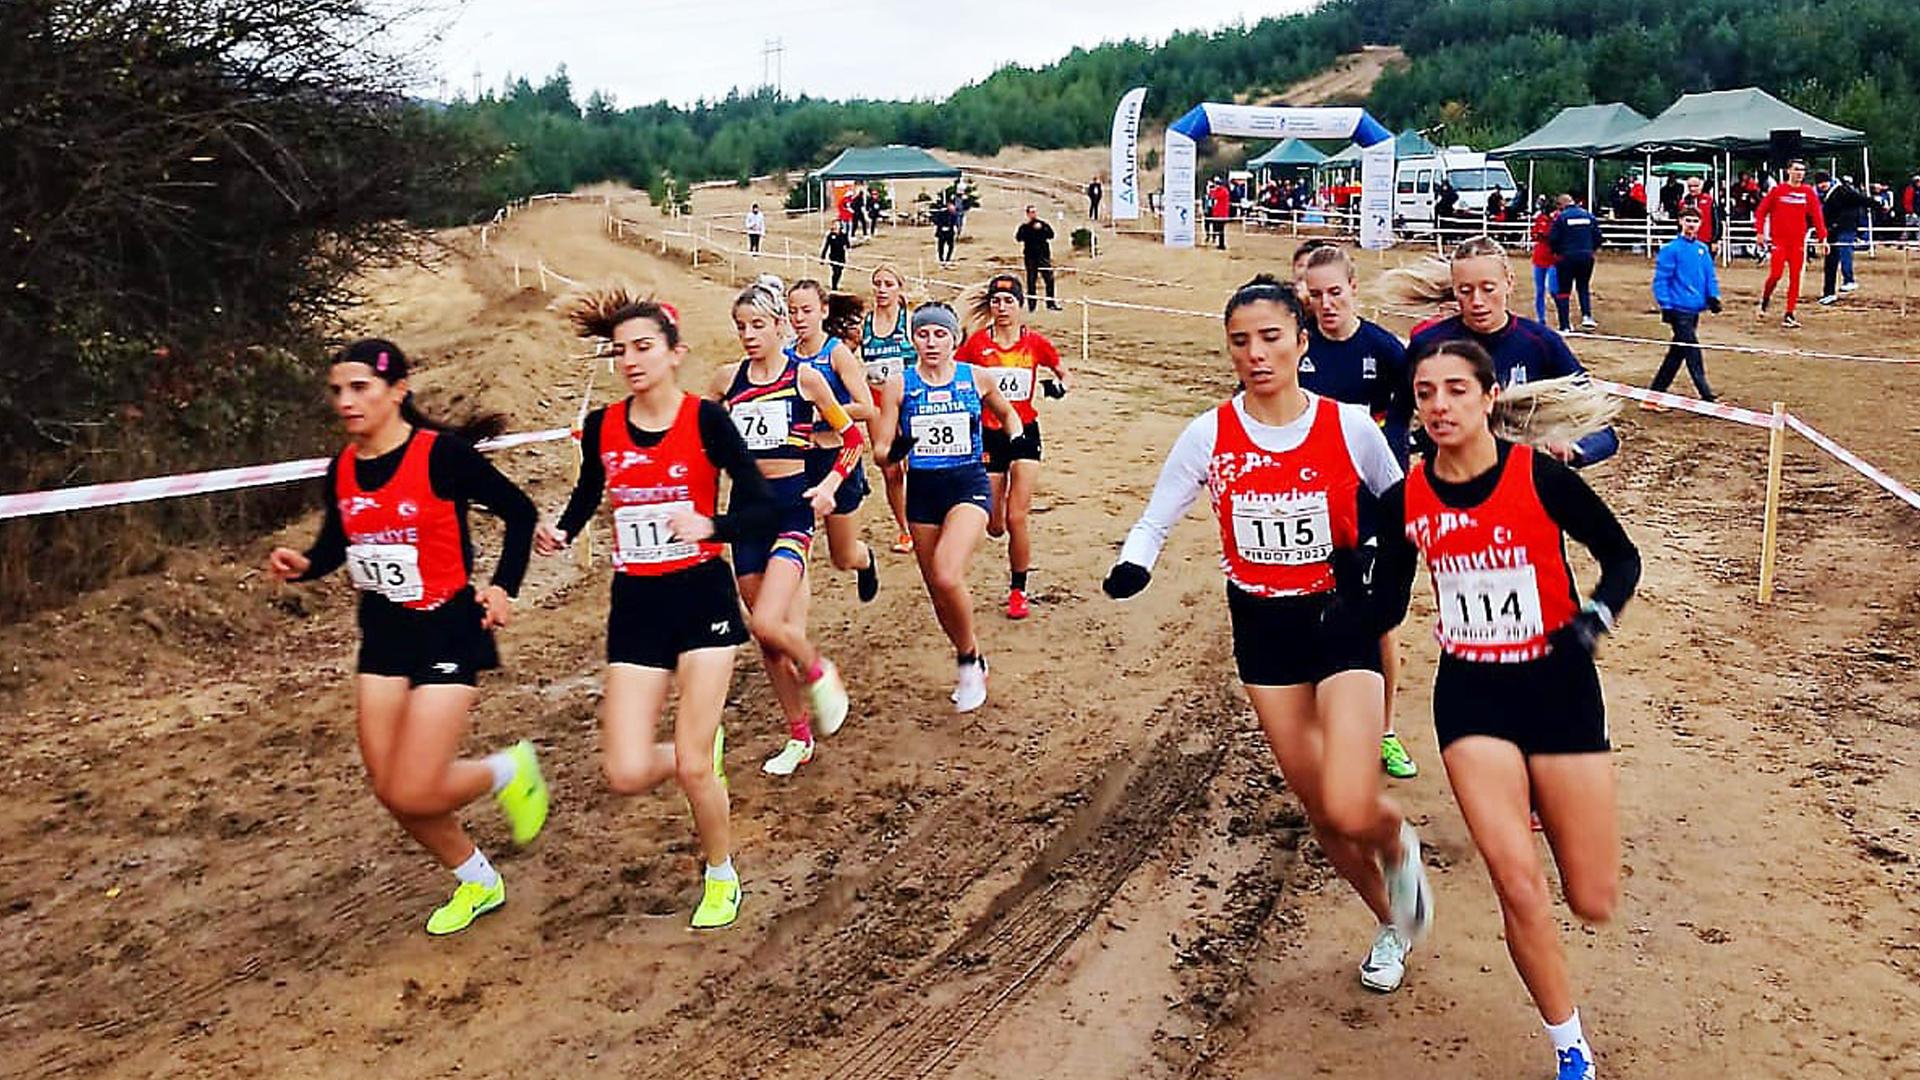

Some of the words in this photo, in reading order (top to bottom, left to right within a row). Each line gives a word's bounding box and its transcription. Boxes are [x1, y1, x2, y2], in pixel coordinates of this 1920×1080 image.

[1122, 101, 1136, 187] Aurubis
[999, 376, 1018, 392] 66
[919, 400, 967, 415] CROATIA
[742, 416, 768, 436] 76
[928, 426, 954, 445] 38
[1251, 518, 1314, 548] 115
[357, 560, 406, 586] 113
[1456, 589, 1522, 625] 114
